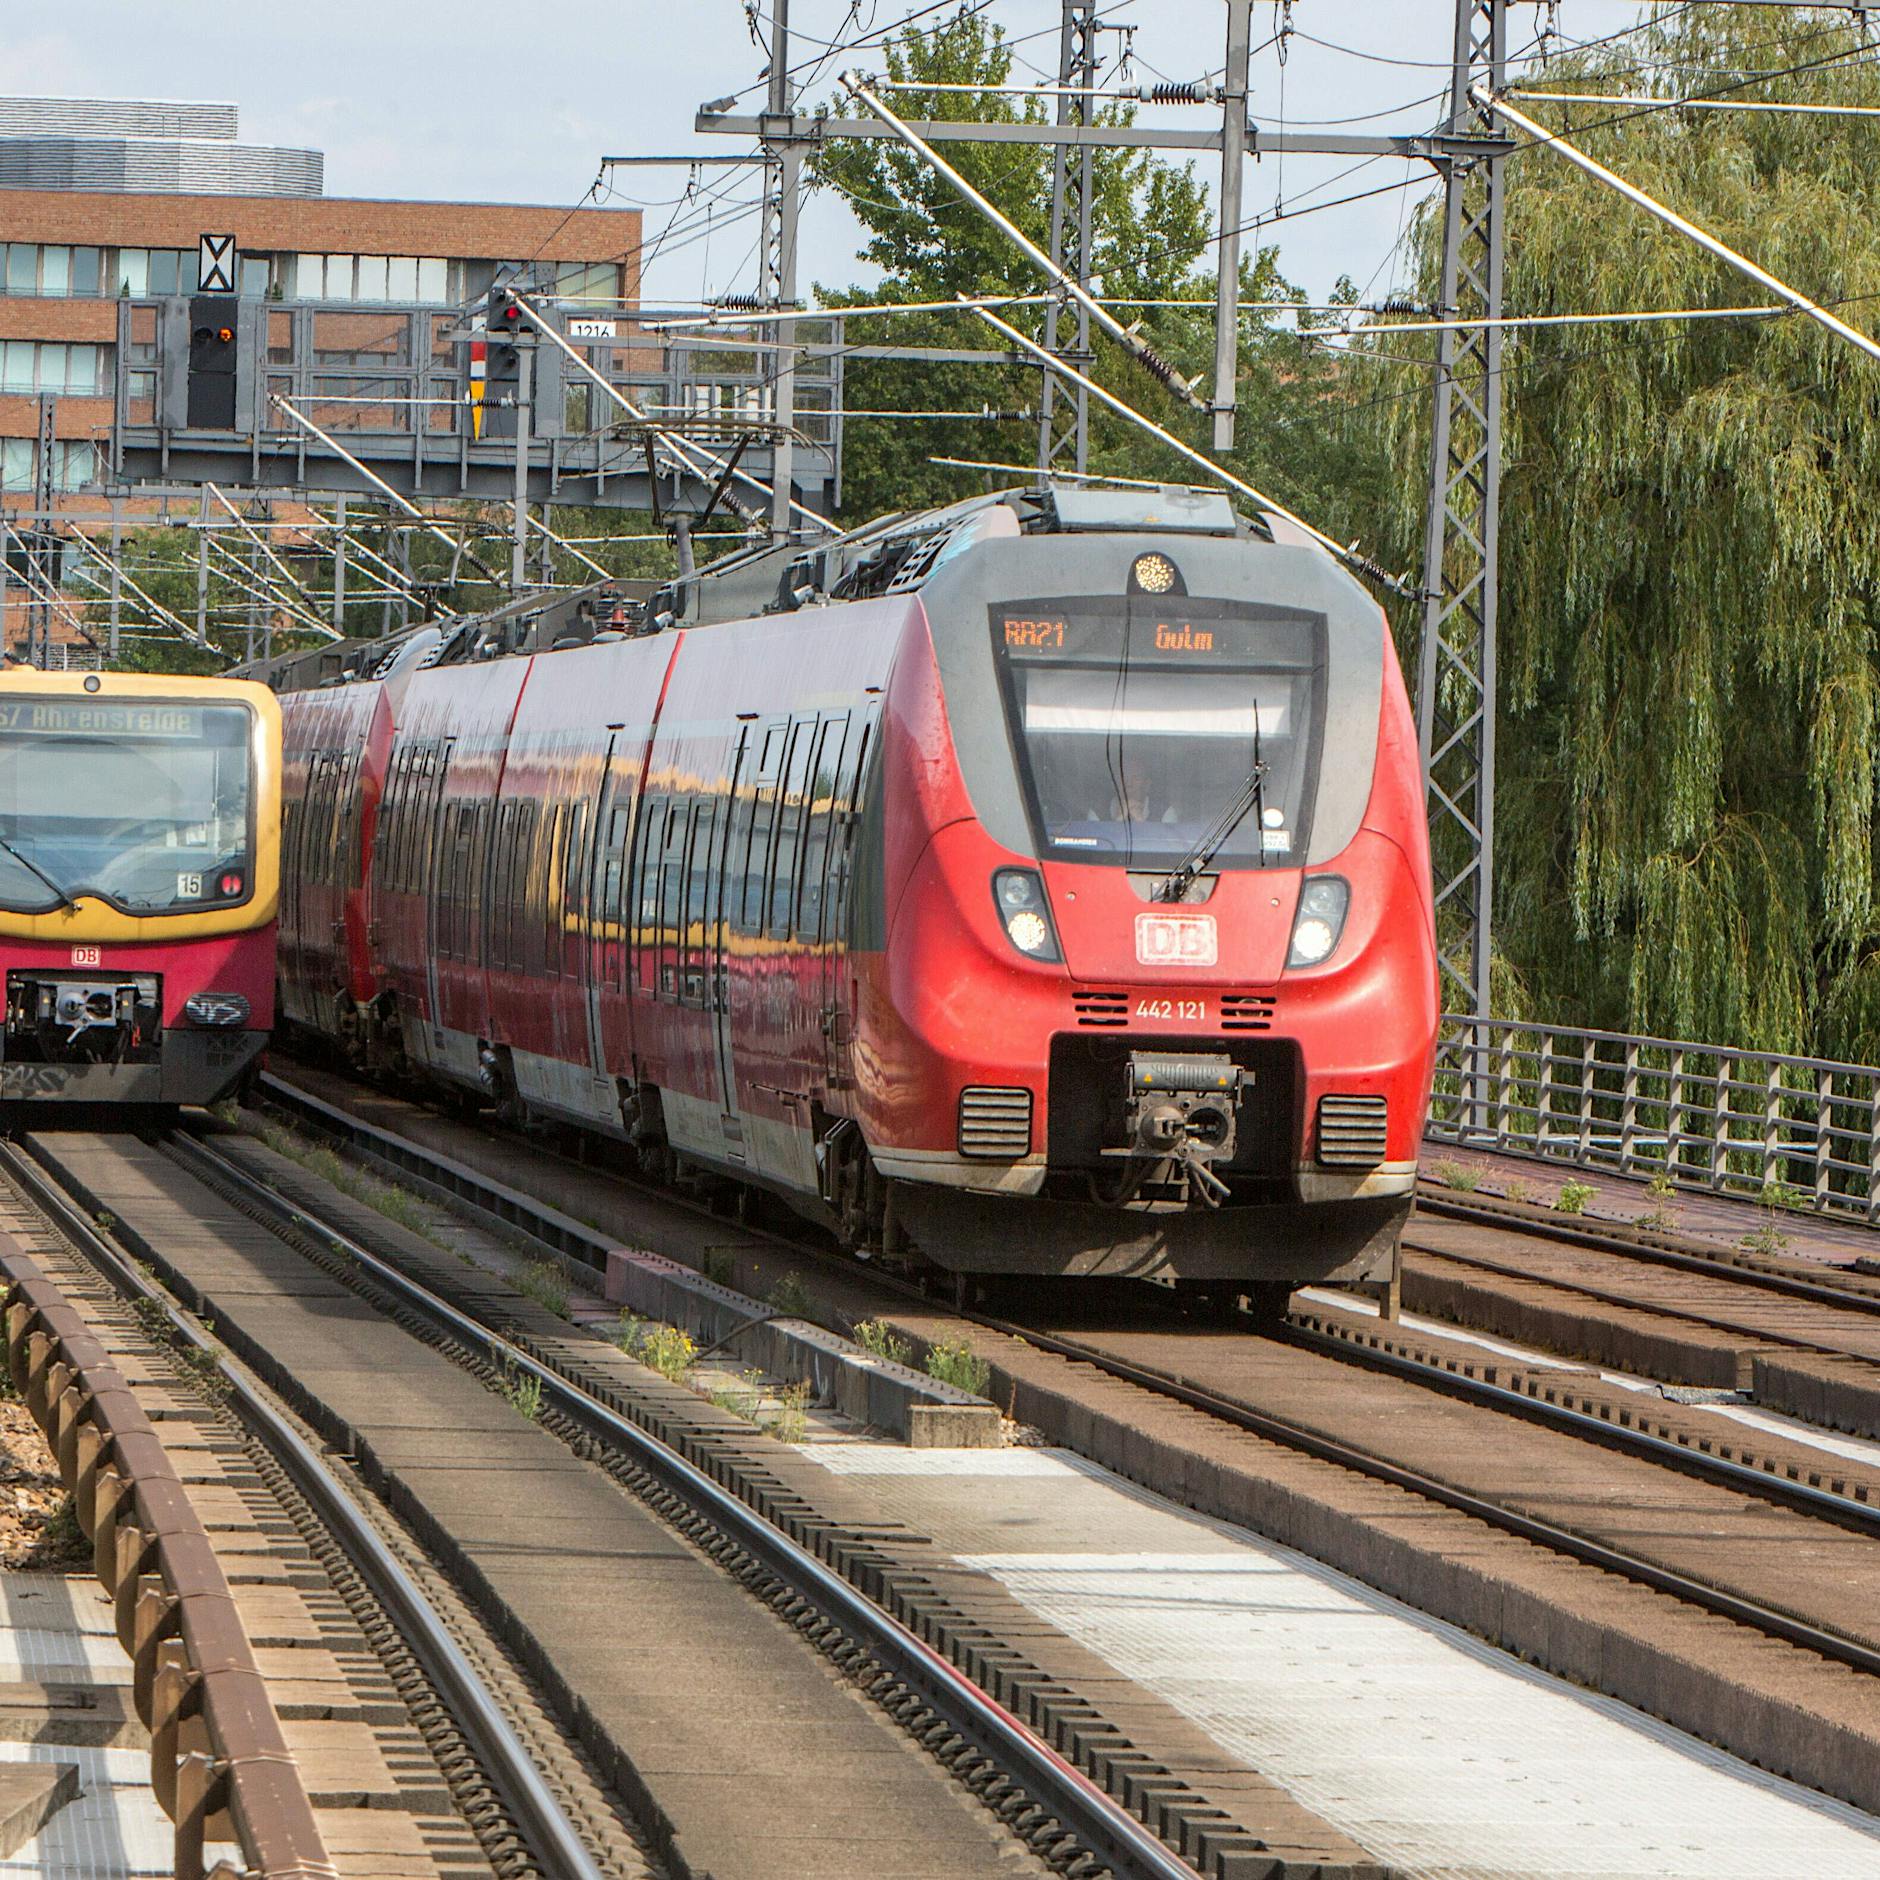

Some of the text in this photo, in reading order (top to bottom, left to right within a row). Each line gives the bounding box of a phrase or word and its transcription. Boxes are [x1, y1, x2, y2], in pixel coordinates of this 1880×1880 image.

[577, 324, 610, 338] 1216
[33, 704, 192, 732] Ahrensfelde
[181, 876, 200, 894] 15
[1143, 919, 1211, 960] DB
[75, 948, 98, 964] DB
[1136, 1000, 1206, 1020] 442 121
